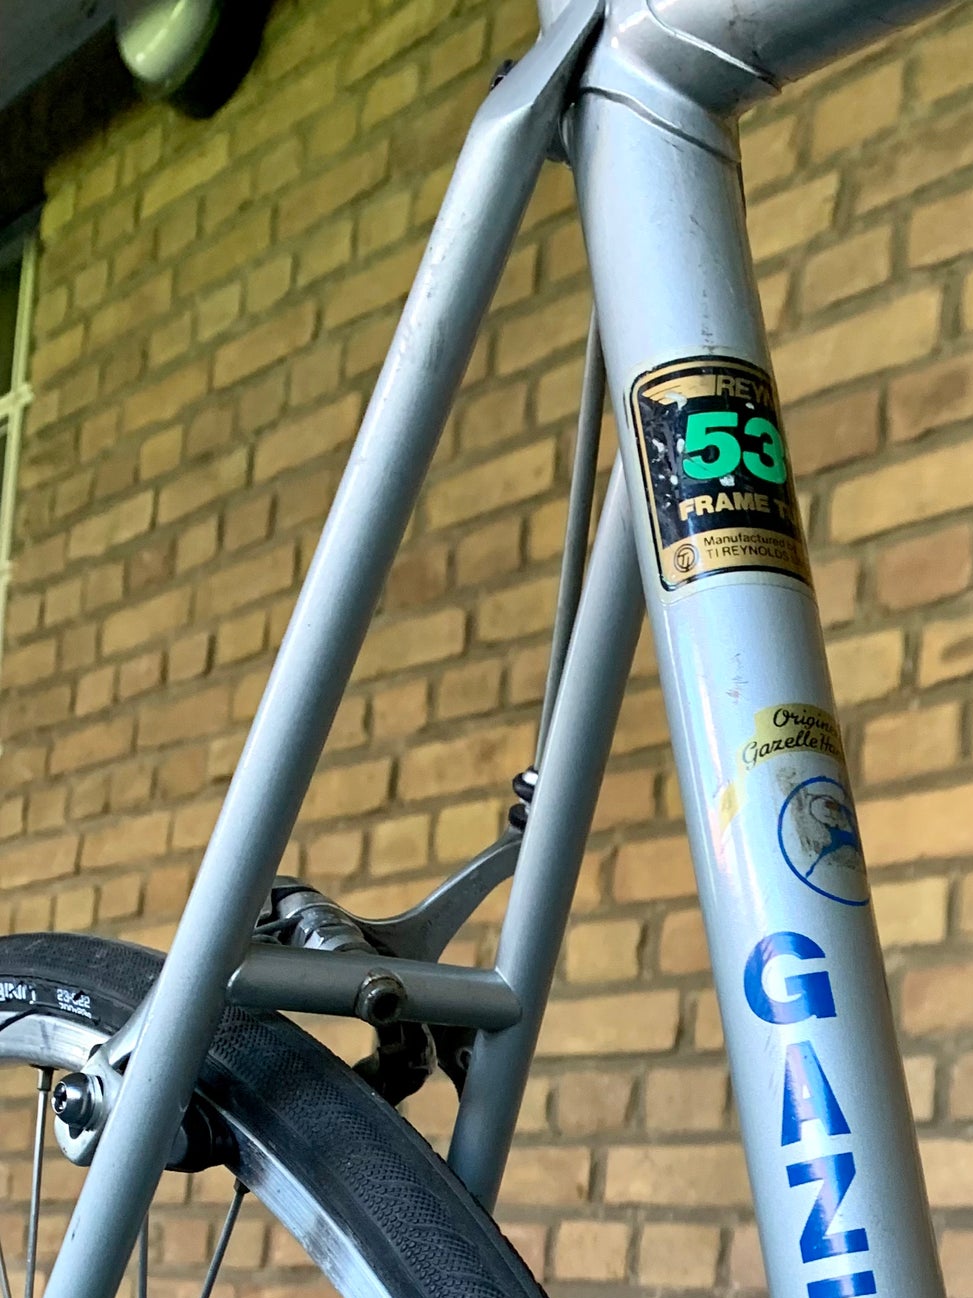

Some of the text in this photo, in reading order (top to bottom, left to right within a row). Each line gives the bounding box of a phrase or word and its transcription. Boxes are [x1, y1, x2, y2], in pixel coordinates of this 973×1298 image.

[678, 493, 770, 521] FRAME
[704, 532, 785, 547] Manufactured
[722, 545, 790, 562] REYNOLDS
[742, 730, 818, 770] Gazelle
